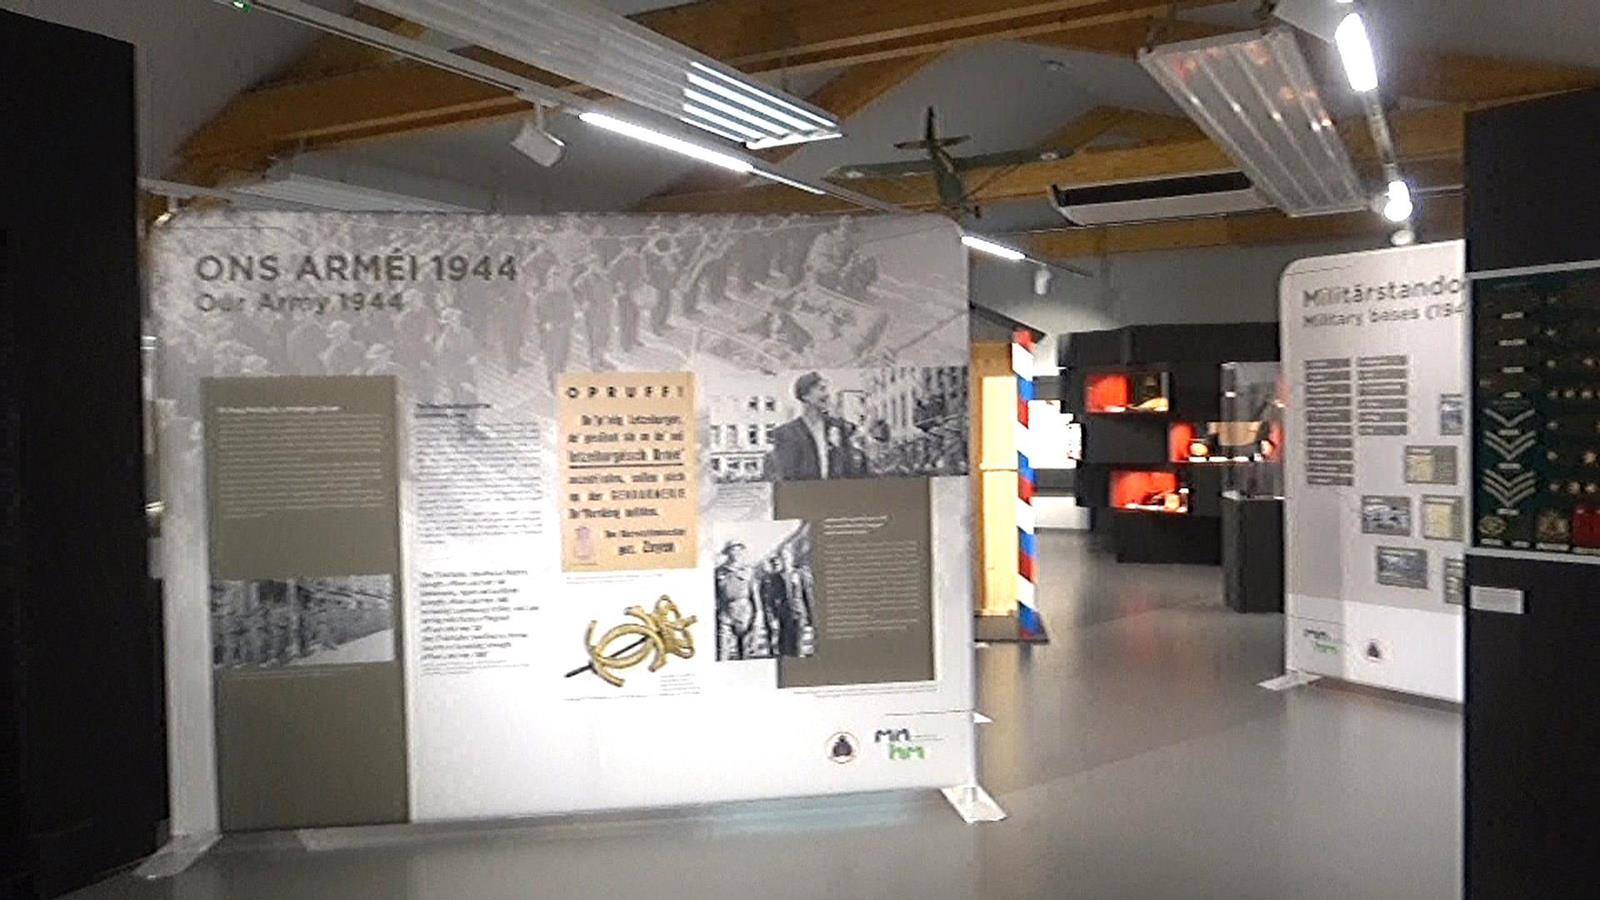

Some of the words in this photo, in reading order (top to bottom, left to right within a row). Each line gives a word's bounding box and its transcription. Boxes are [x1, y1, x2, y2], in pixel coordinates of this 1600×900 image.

[196, 254, 278, 281] ONS
[296, 247, 417, 281] ARMÉI
[430, 254, 517, 281] 1944
[197, 293, 245, 312] Our
[259, 292, 329, 314] Army
[338, 292, 405, 311] 1944
[1369, 307, 1420, 323] bases
